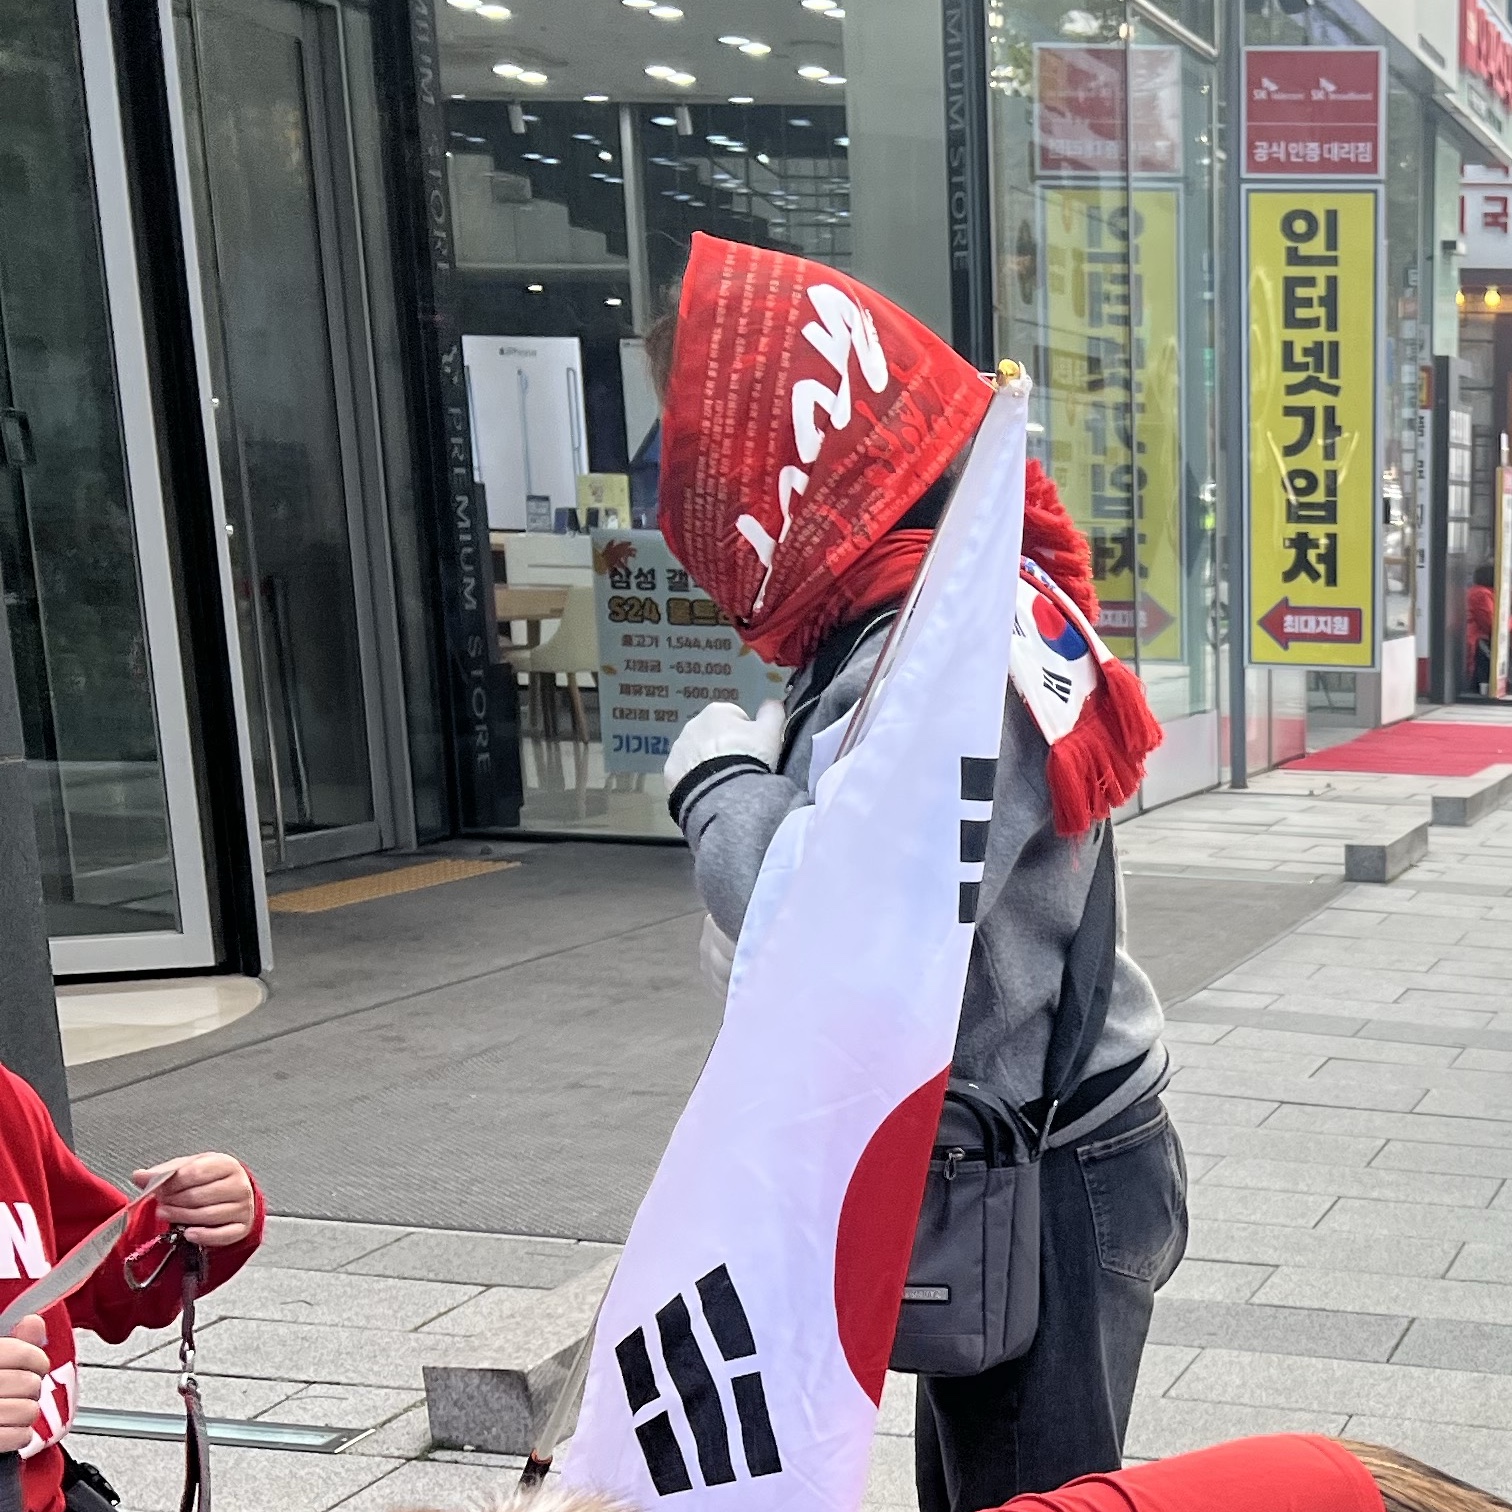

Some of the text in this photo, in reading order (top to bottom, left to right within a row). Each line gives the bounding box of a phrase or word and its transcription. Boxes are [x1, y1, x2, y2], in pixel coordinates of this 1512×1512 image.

[1253, 141, 1373, 163] 공식 인증 대리점
[949, 145, 970, 271] STORE
[1279, 208, 1342, 588] 인터넷가입처
[446, 406, 491, 774] PREMIUM STORE
[609, 567, 699, 592] 삼성 갤
[608, 595, 661, 624] S24
[1283, 613, 1350, 635] 최대지원
